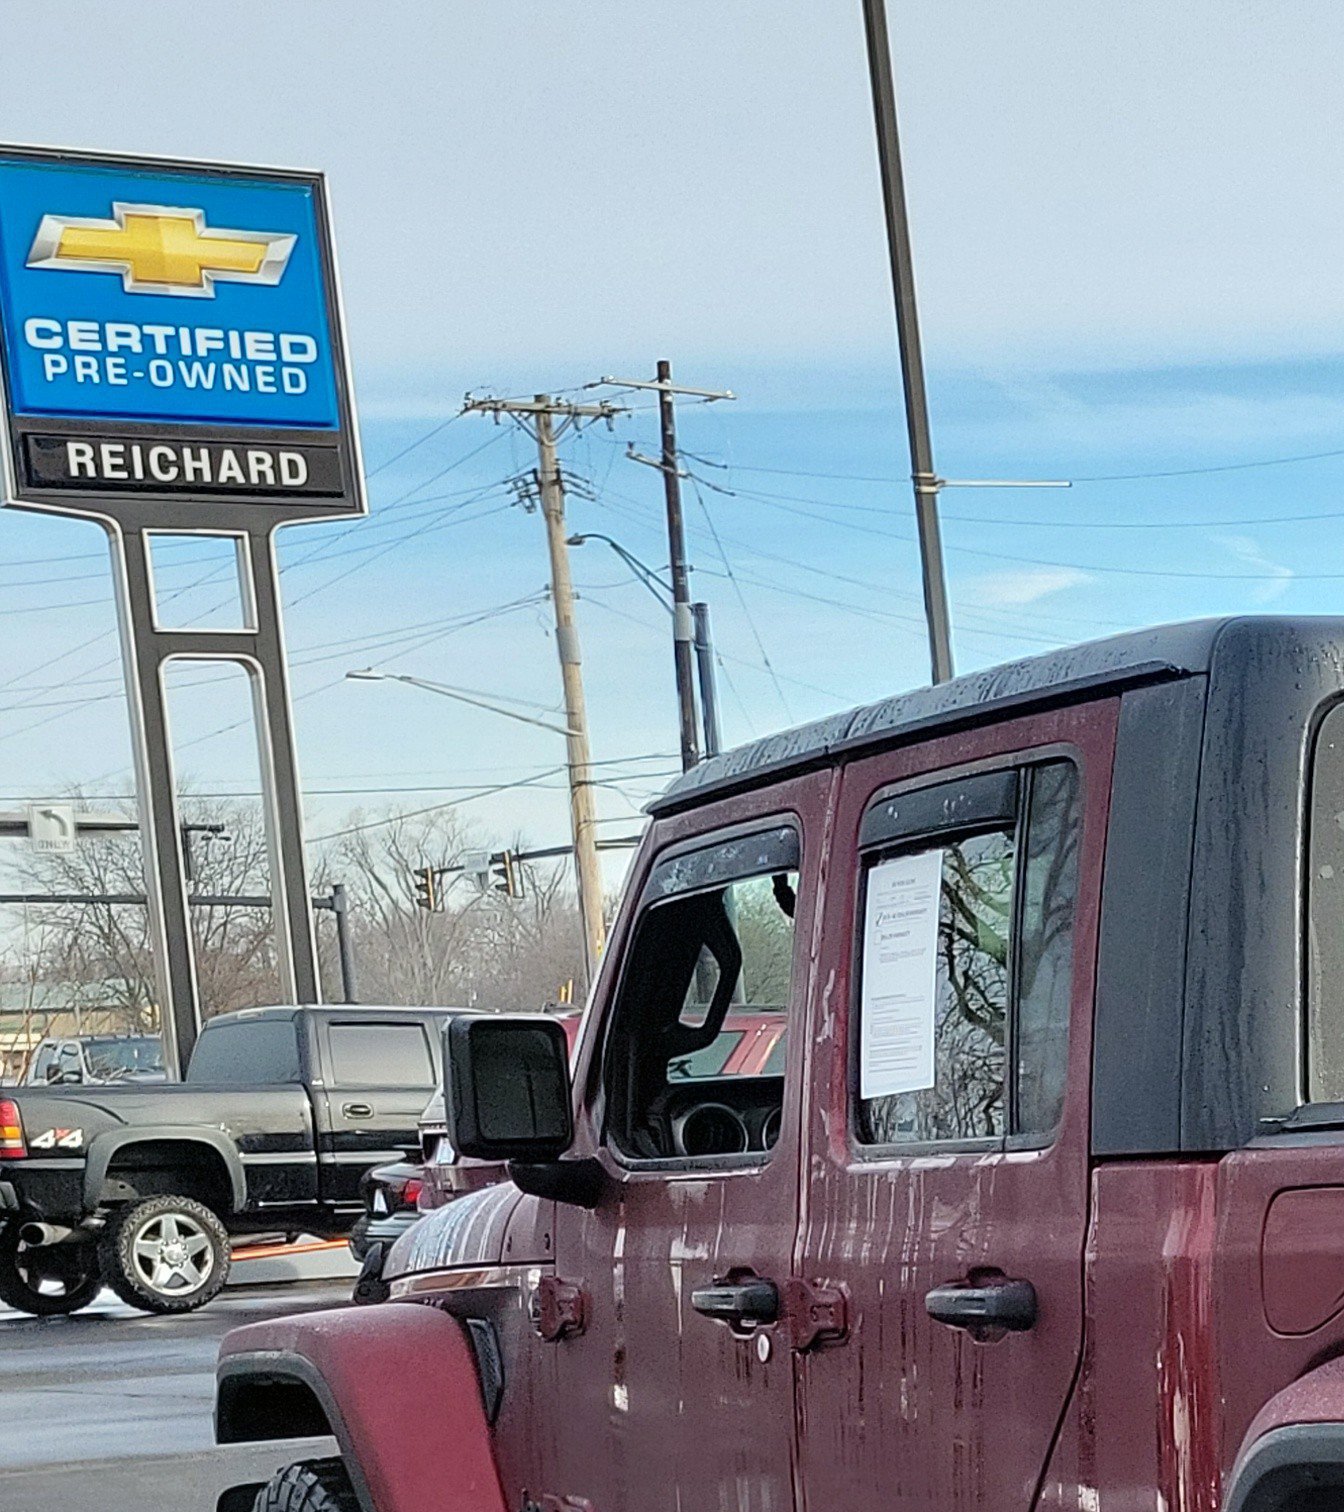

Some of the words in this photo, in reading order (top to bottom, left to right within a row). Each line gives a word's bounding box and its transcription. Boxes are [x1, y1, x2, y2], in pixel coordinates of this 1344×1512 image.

[24, 318, 318, 363] CERTIFIED
[44, 353, 308, 394] PRE-OWNED
[66, 441, 309, 487] REICHARD
